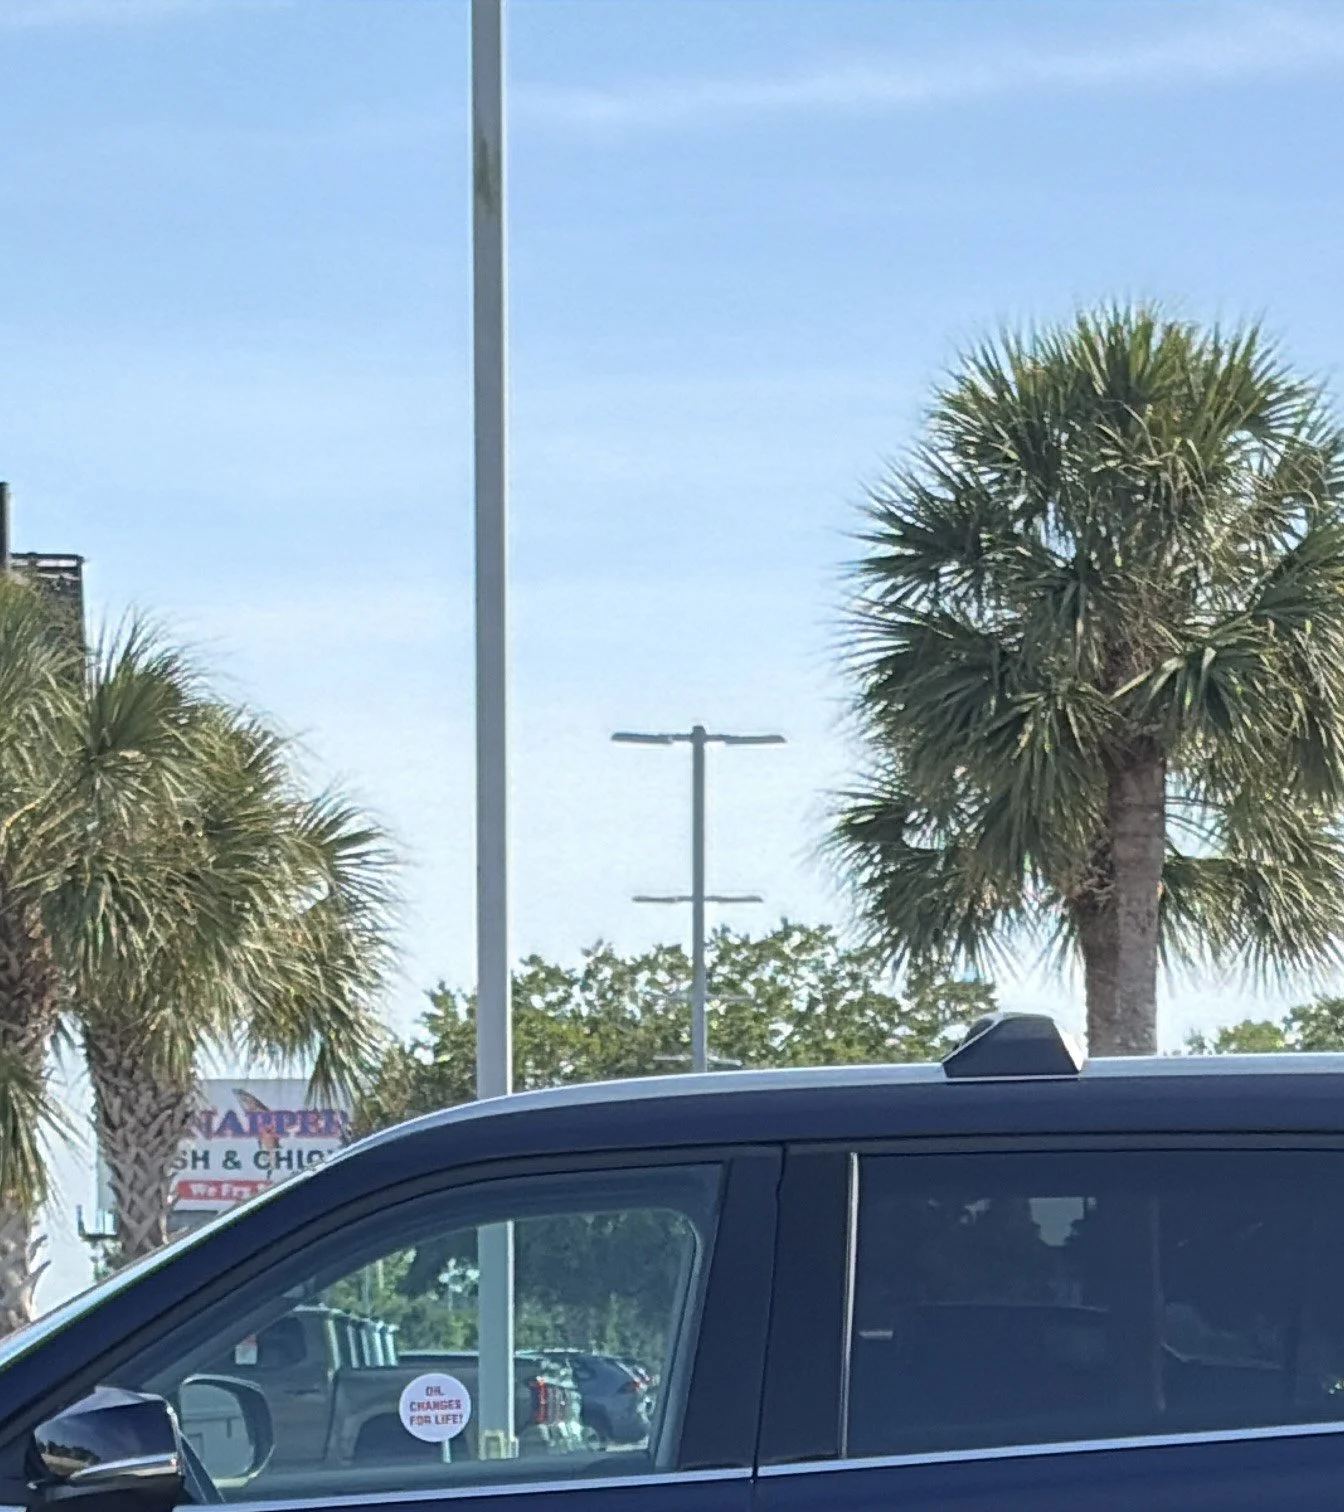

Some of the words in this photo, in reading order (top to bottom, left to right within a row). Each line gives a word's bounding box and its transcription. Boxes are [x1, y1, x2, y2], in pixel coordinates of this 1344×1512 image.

[190, 1109, 349, 1140] NAPPER
[174, 1149, 211, 1171] SH
[222, 1149, 242, 1171] &
[425, 1386, 445, 1397] OIL
[409, 1399, 462, 1412] CHANGES
[409, 1415, 432, 1427] FOR
[434, 1413, 464, 1426] LIFE!
